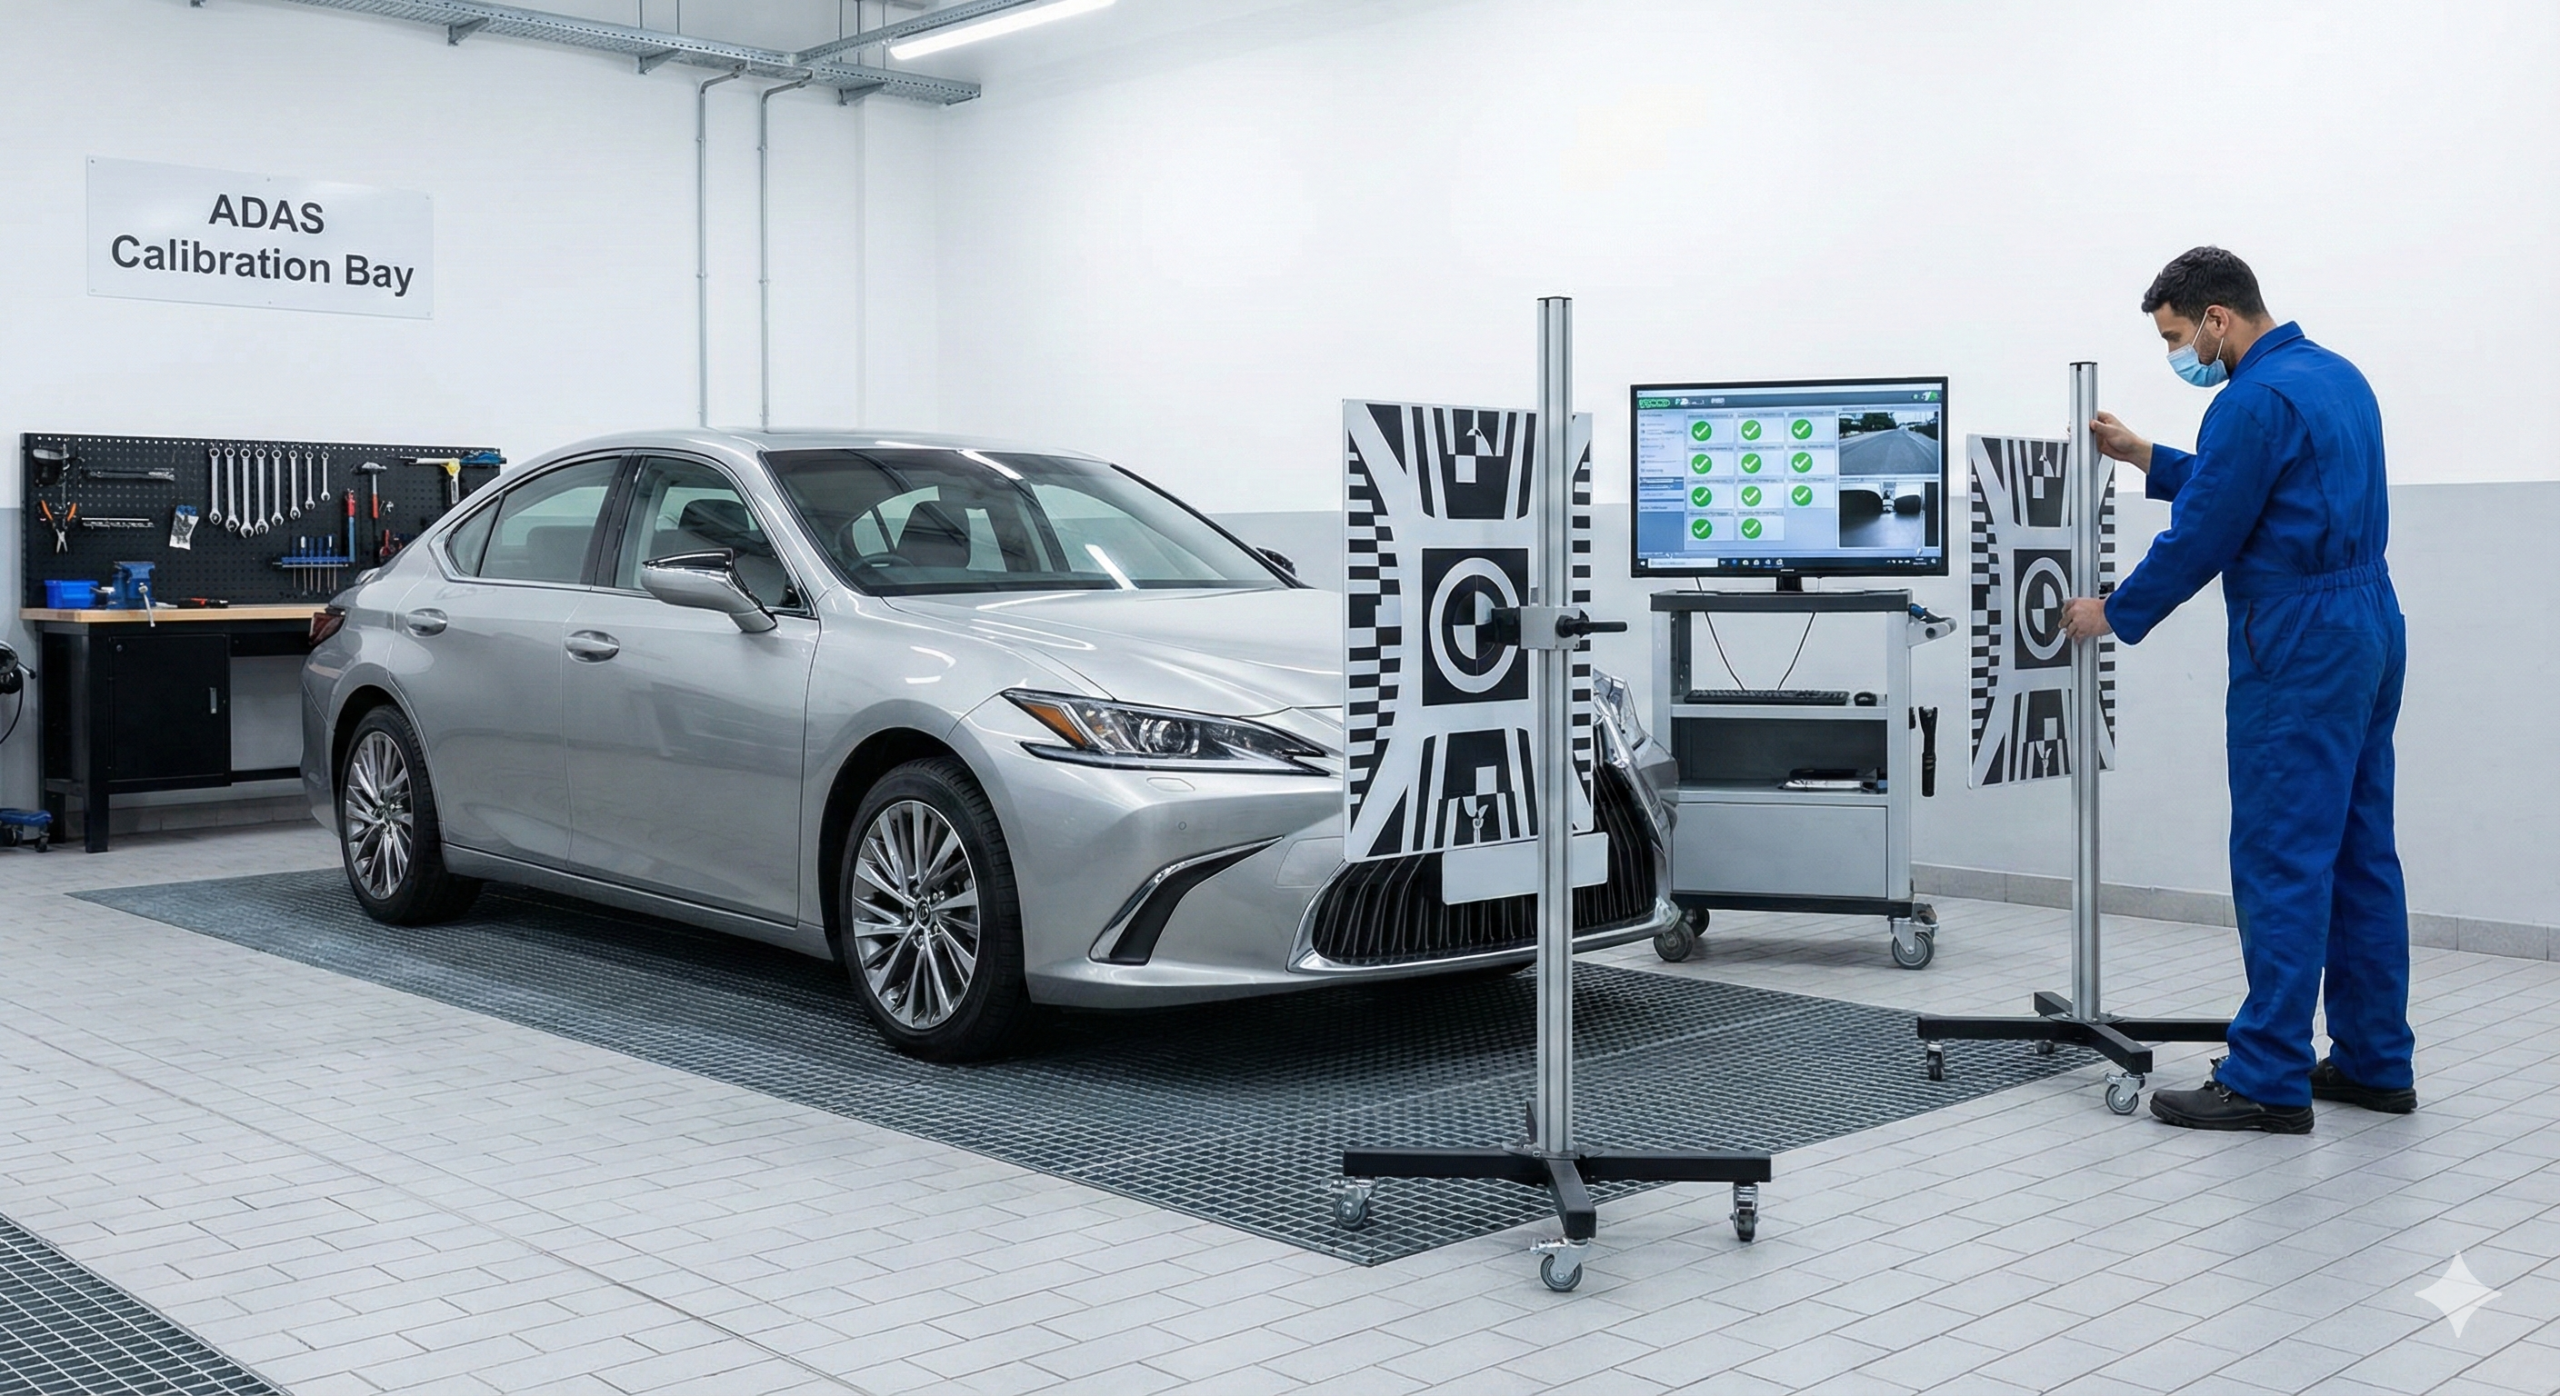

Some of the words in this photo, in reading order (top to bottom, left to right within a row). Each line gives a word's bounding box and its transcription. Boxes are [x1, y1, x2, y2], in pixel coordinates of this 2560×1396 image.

[209, 194, 325, 235] ADAS
[111, 234, 330, 284] Calibration
[345, 254, 414, 297] Bay
